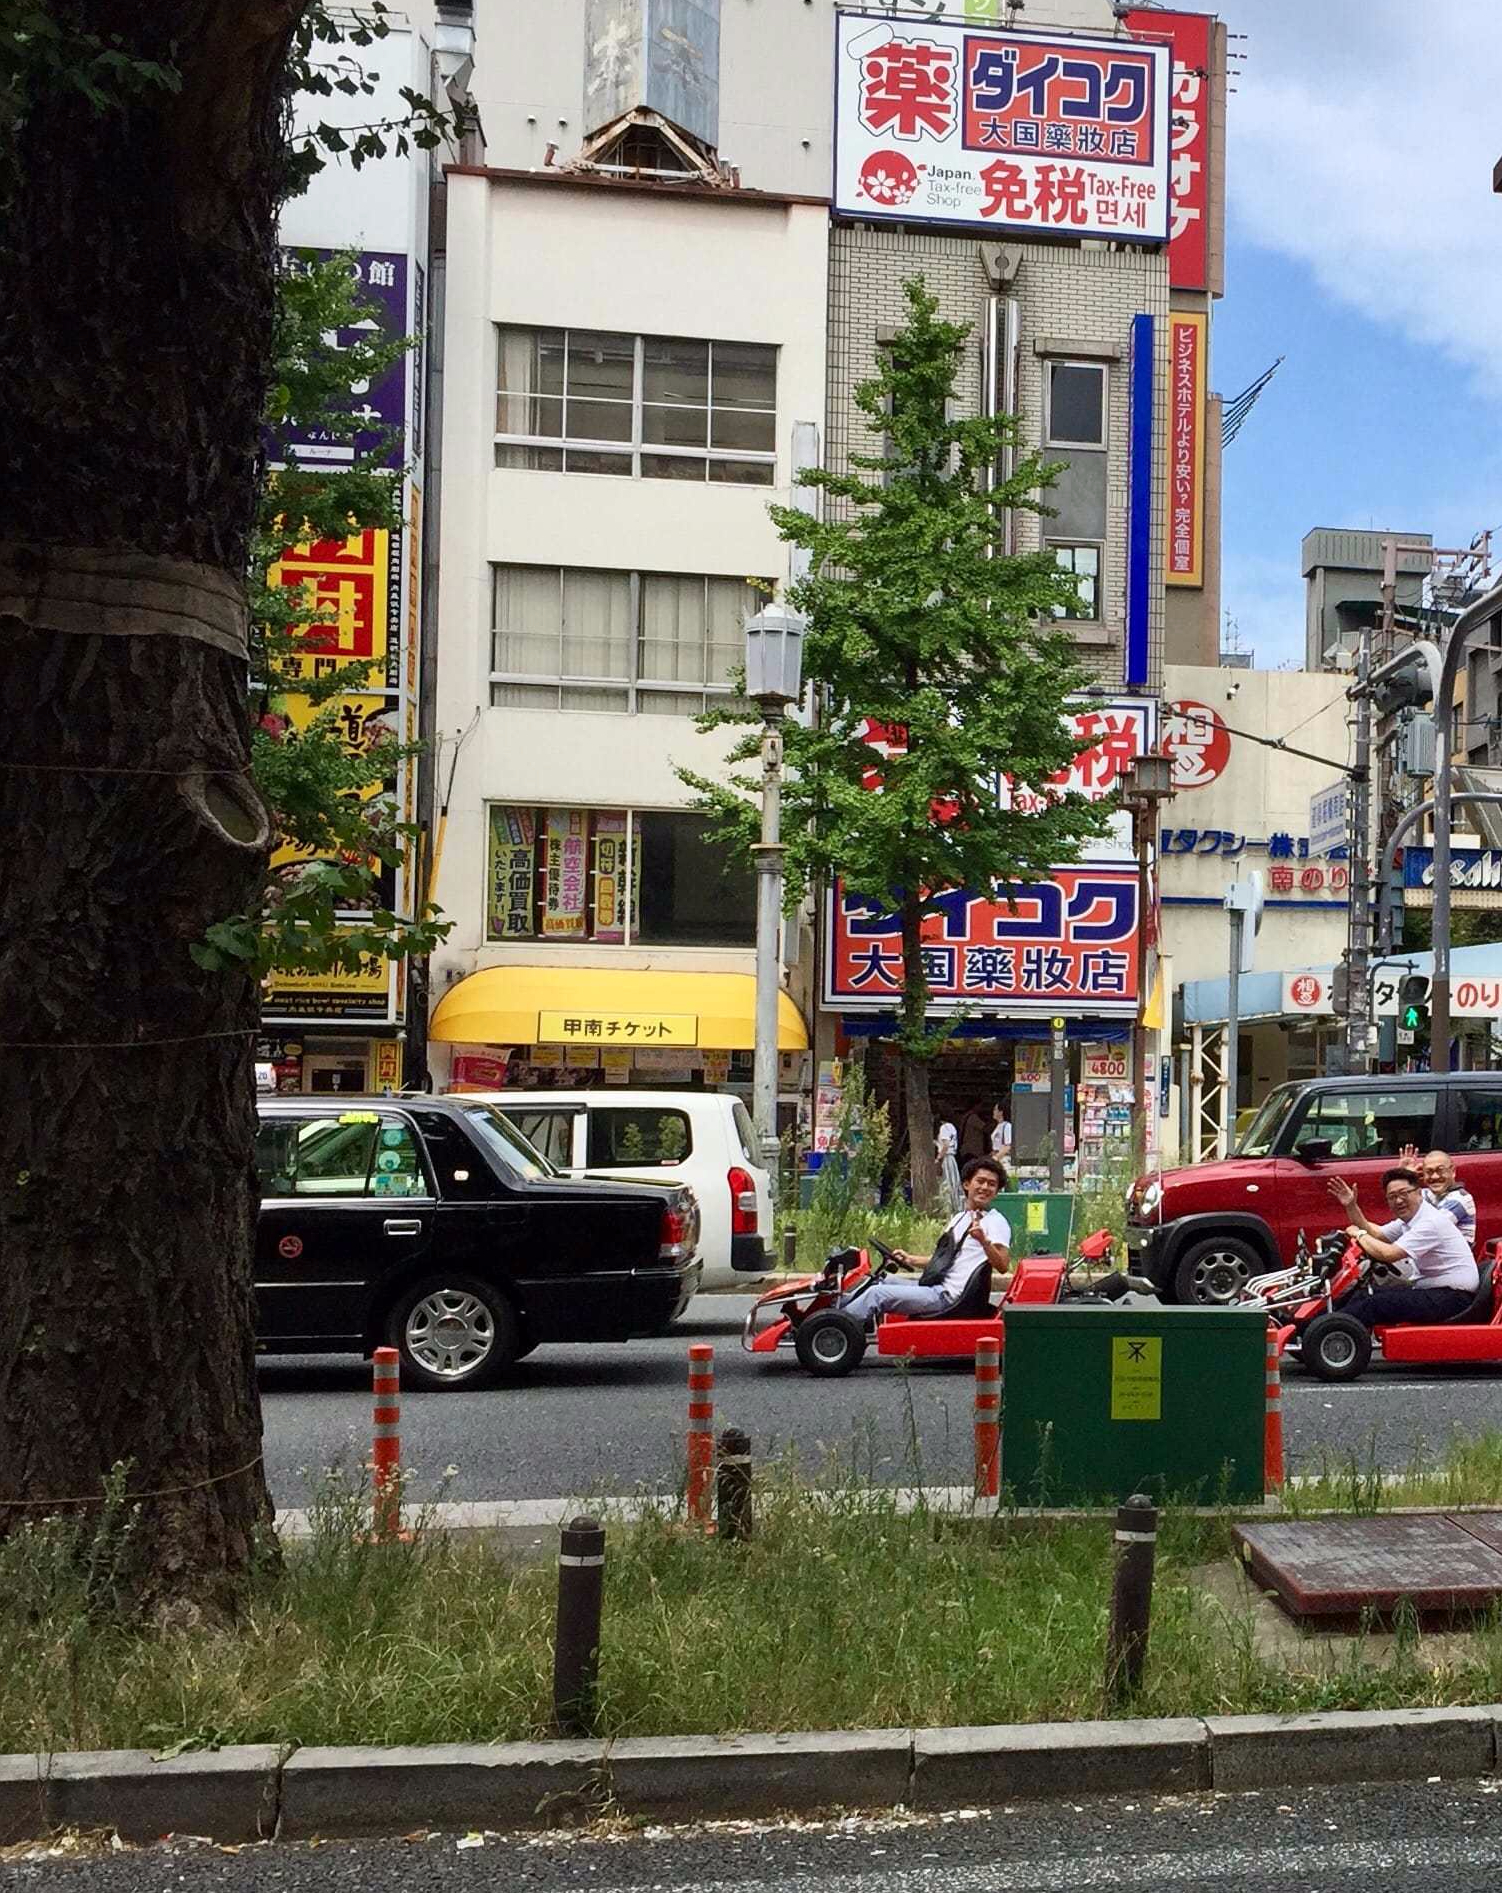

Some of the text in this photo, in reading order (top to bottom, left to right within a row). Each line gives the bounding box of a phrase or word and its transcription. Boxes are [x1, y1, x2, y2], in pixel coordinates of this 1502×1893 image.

[864, 42, 954, 137] 薬
[970, 49, 1148, 122] ダイコク
[926, 193, 962, 209] Shop
[928, 180, 983, 196] Tax-free
[979, 159, 1088, 226] 免税
[1088, 172, 1156, 201] Tax-Free
[1095, 199, 1147, 230] 면세
[1174, 508, 1191, 571] 完全個室
[508, 848, 531, 934] 高価買取
[562, 1017, 672, 1039] 甲南チケット
